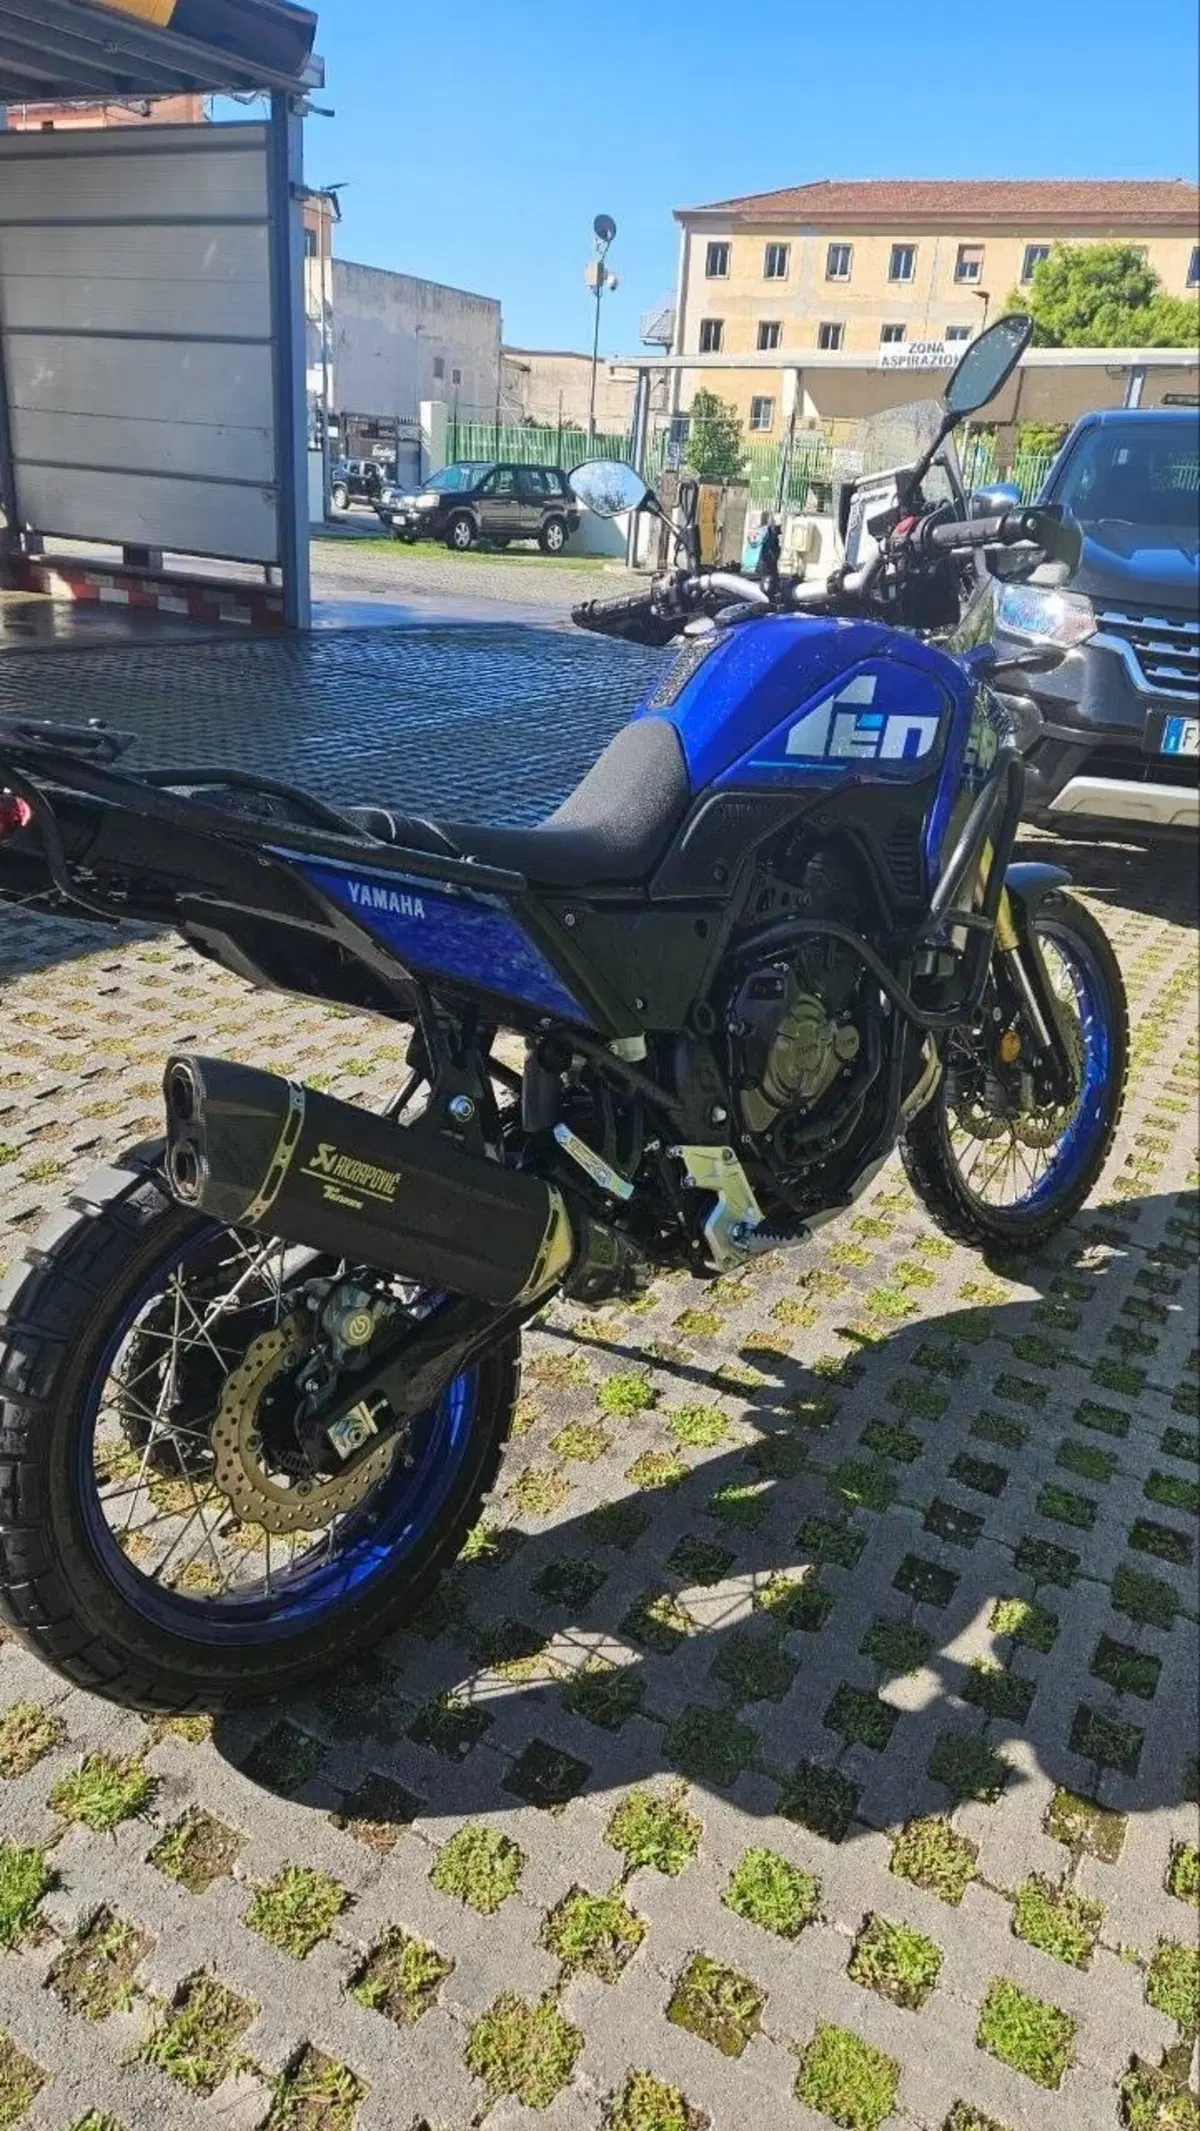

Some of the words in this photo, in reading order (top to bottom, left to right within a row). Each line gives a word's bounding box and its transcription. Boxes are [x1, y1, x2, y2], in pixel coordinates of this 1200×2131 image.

[908, 341, 945, 354] ZONA
[1182, 726, 1200, 748] F
[347, 881, 425, 919] YAMAHA
